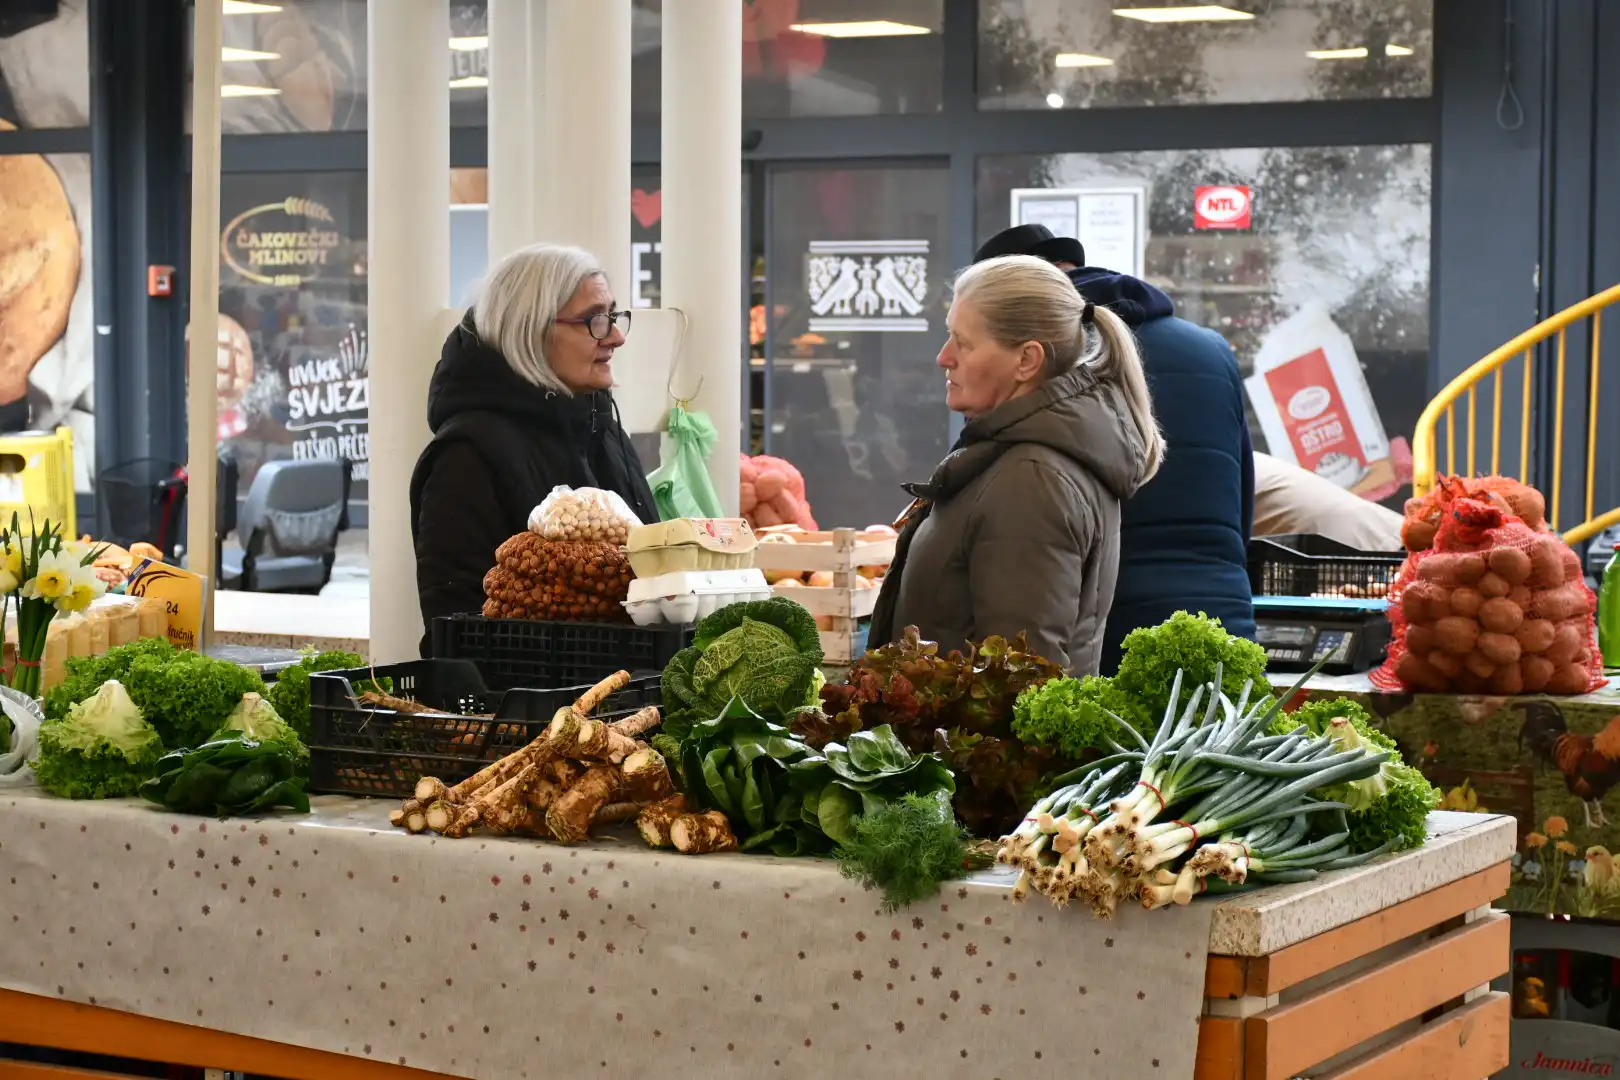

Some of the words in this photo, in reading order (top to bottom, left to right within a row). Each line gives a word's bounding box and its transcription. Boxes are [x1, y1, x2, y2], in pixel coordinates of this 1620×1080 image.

[1208, 197, 1237, 212] NTL
[236, 228, 338, 249] ČAKOVEČKI
[248, 249, 327, 265] MLINOVI
[166, 600, 179, 616] 24
[1521, 1050, 1613, 1076] Jamnica
